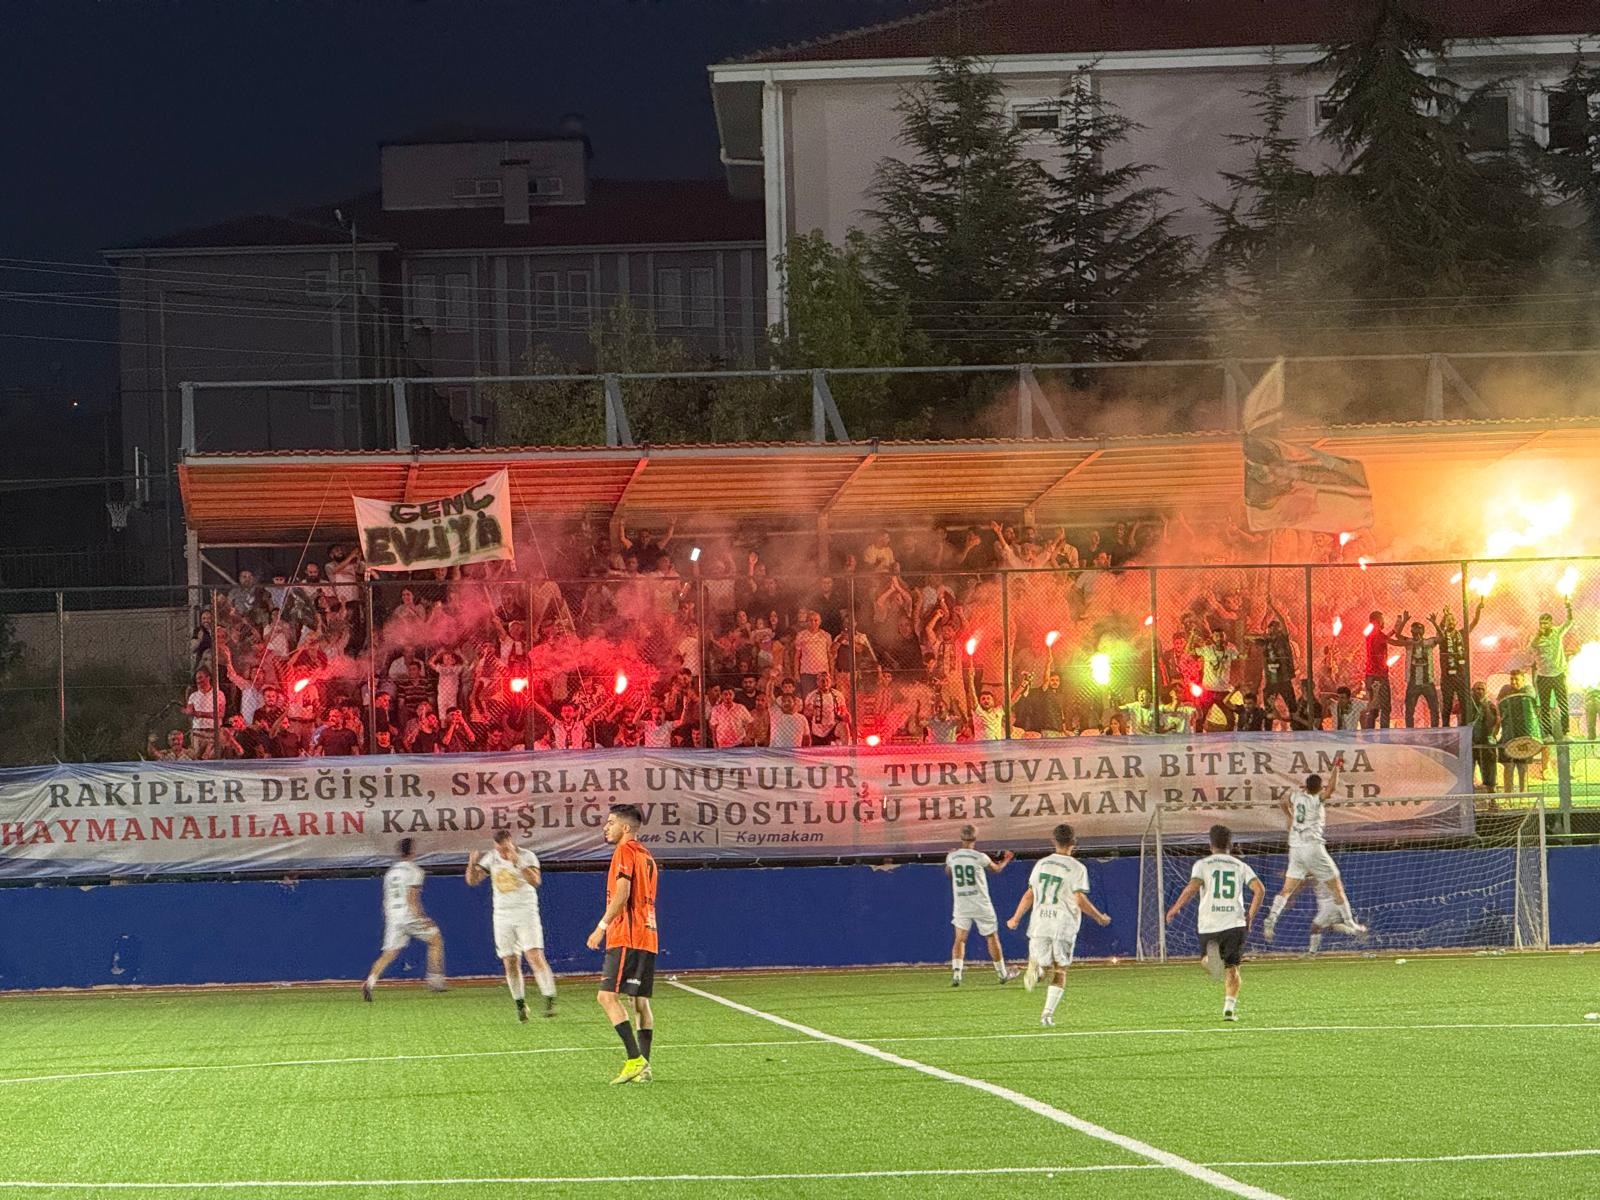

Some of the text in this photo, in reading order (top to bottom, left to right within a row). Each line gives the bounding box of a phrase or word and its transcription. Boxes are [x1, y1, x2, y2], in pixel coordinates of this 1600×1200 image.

[49, 746, 1375, 808] RAKİPLER DEĞİŞİR, SKORLAR UNUTULUR, TURNUVALAR BİTER AMA
[1, 810, 366, 846] HAYMANALILARIN
[381, 796, 618, 837] KARDEŞLİĞ
[633, 801, 681, 826] VE
[918, 793, 995, 821] HER
[1010, 789, 1147, 818] ZAMAN
[1163, 778, 1253, 811] BAKİ
[665, 830, 705, 843] SAK
[736, 831, 824, 845] Kaymakam
[954, 864, 976, 887] 99
[1039, 872, 1063, 904] 77
[1212, 870, 1236, 899] 15
